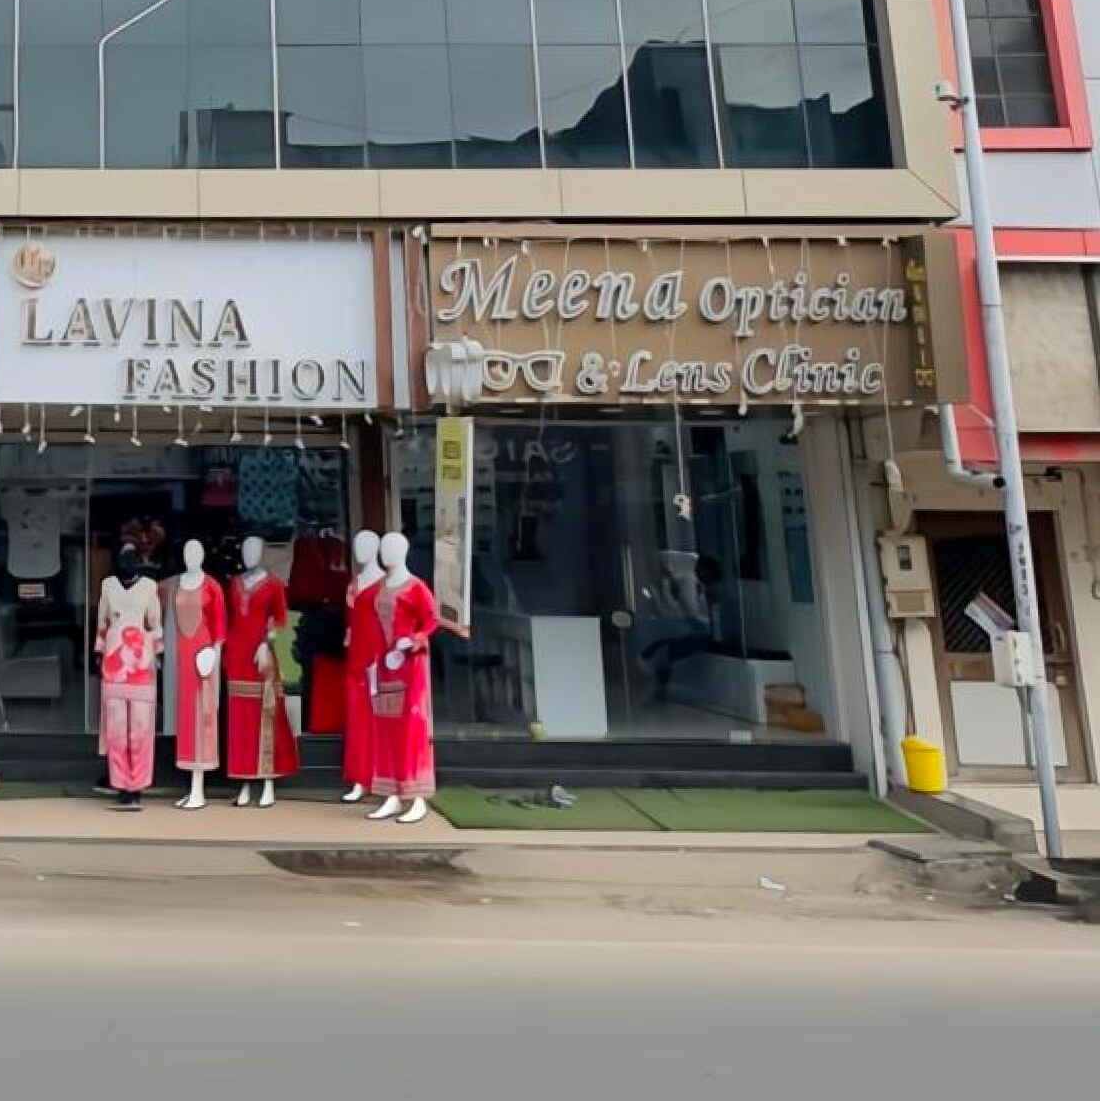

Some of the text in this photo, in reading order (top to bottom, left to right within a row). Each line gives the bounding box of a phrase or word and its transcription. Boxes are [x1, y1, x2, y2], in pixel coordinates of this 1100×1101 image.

[437, 254, 688, 322] Meena
[699, 269, 908, 338] Optician
[21, 297, 251, 348] LAVINA
[122, 357, 366, 402] FASHION
[575, 343, 886, 396] & Lens Clinic
